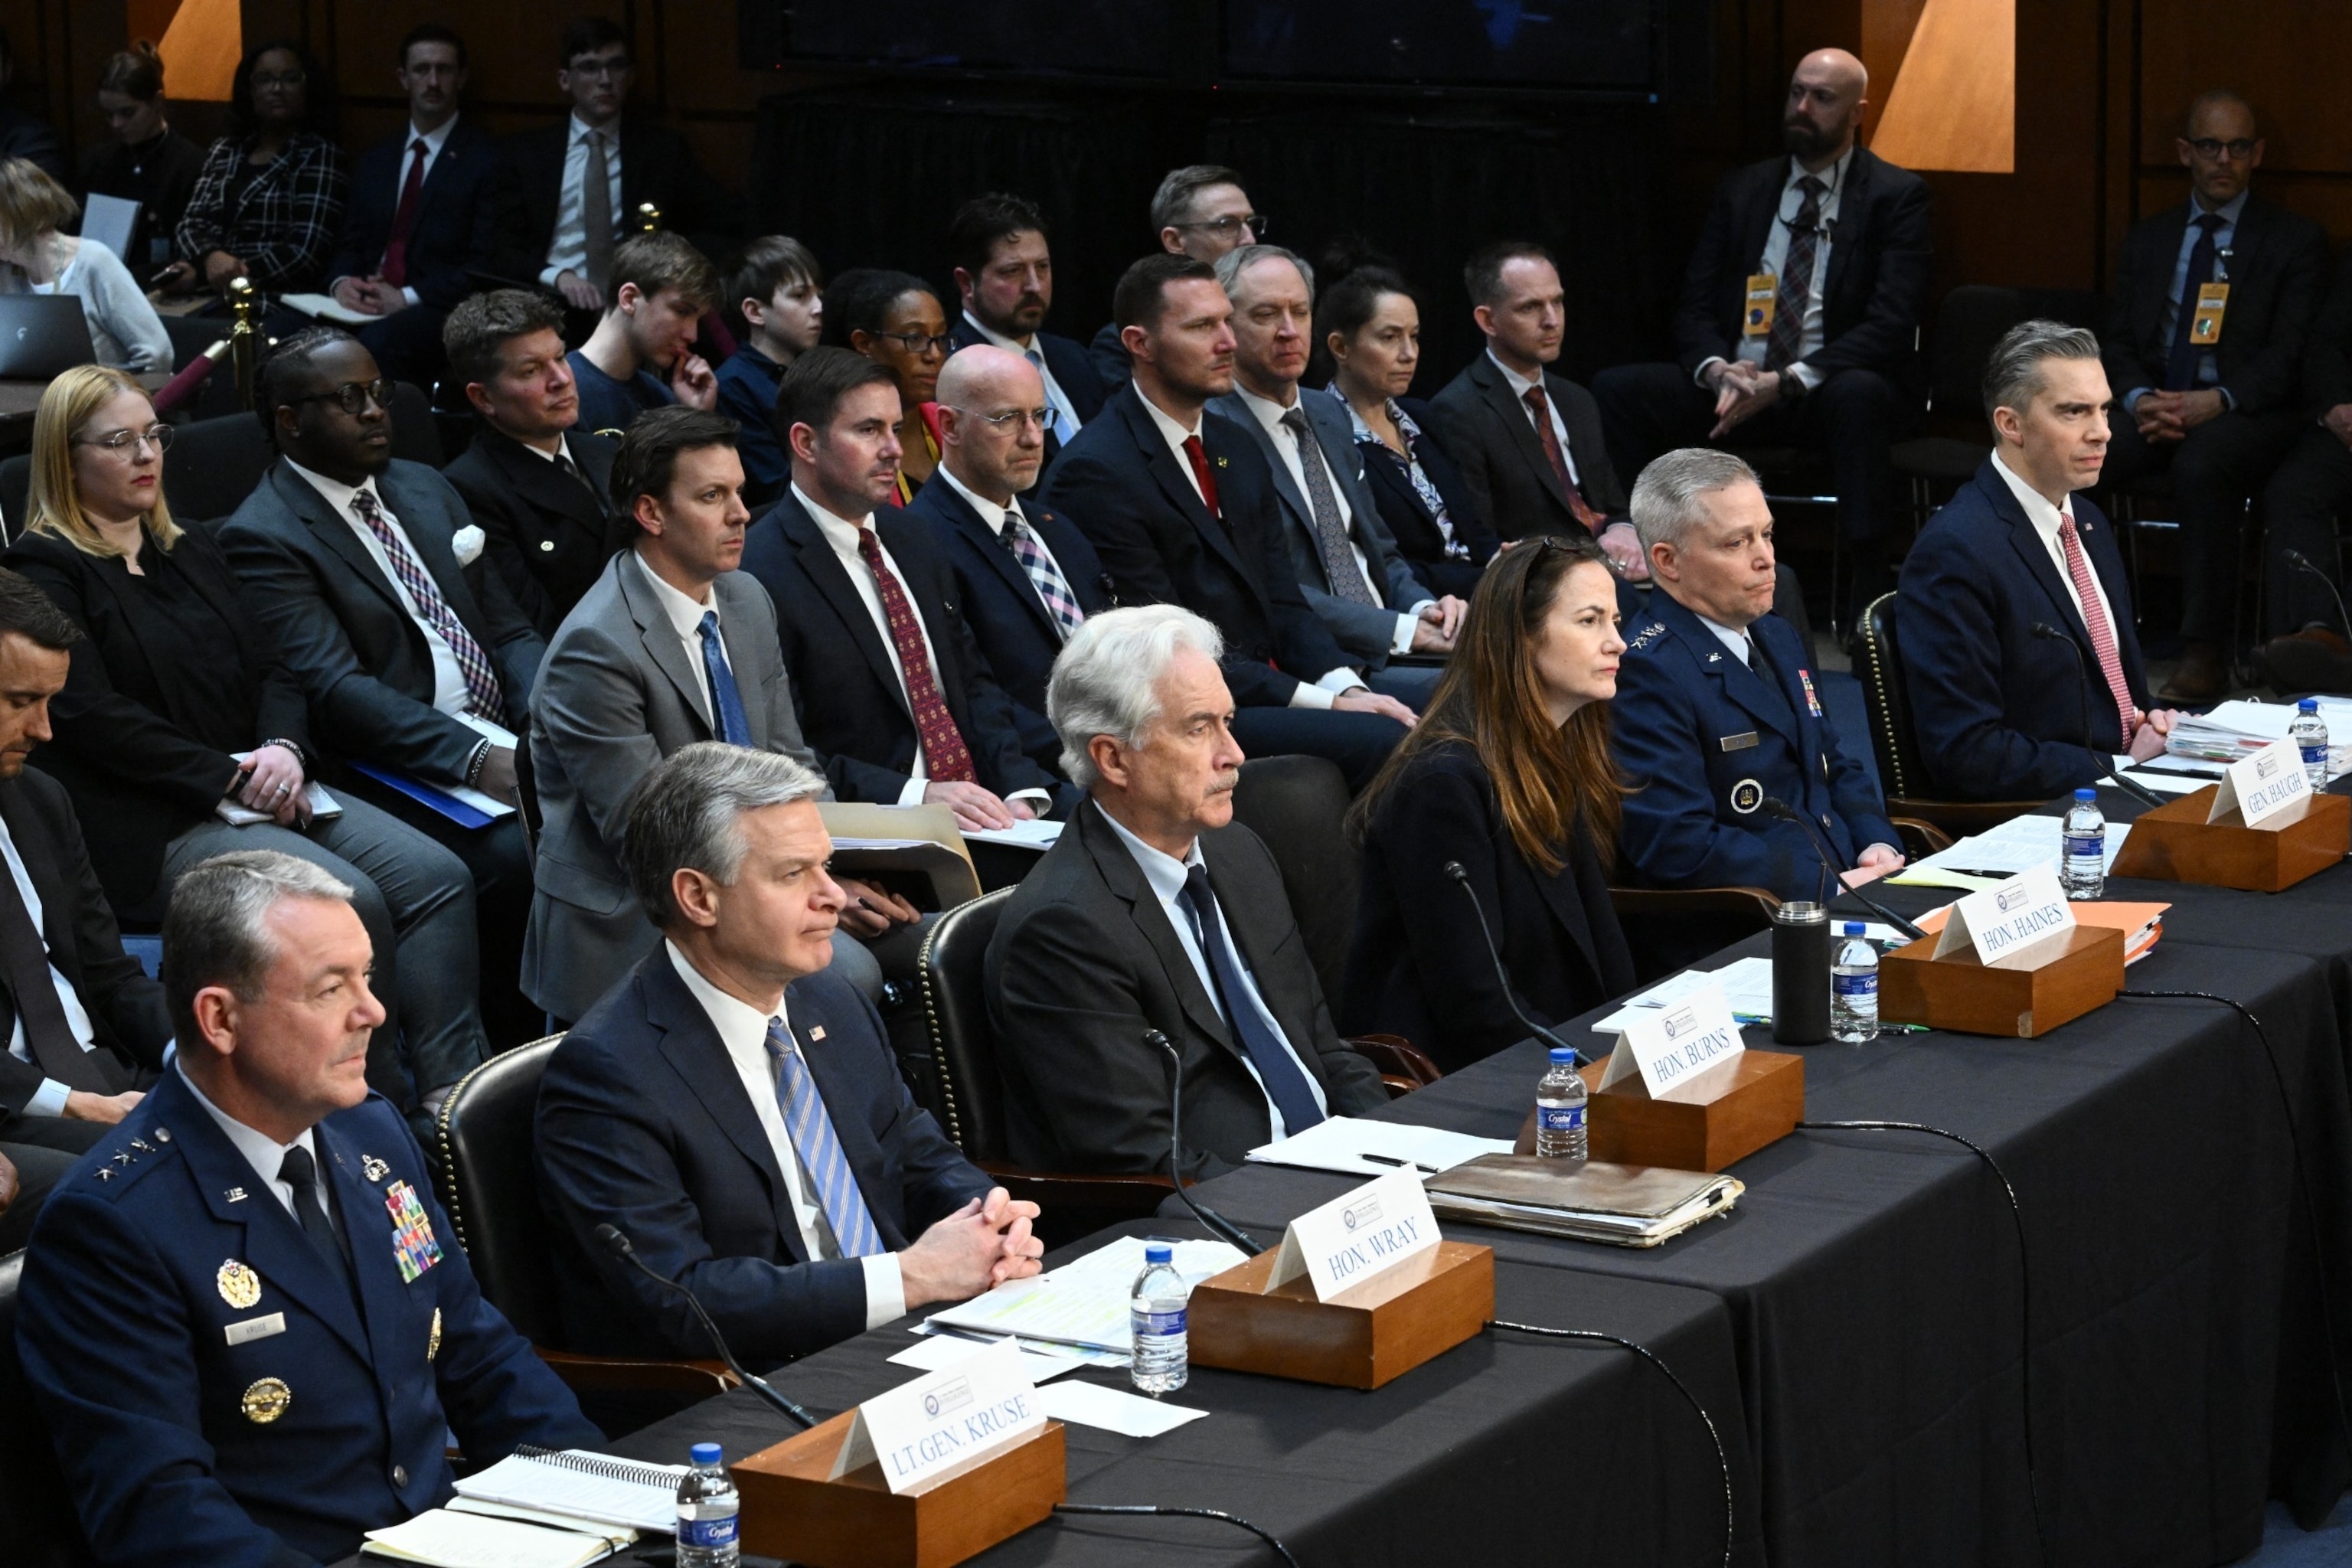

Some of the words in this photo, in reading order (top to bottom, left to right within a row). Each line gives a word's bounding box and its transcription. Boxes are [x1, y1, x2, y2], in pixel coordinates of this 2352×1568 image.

[2248, 789, 2270, 814] GEN.
[2269, 772, 2303, 803] HAUGH
[1982, 923, 2017, 952] HON.
[2014, 903, 2063, 939] HAINES
[1653, 1050, 1687, 1083] HON.
[1684, 1027, 1730, 1066] BURNS
[1549, 1114, 1572, 1124] Crystal
[1328, 1244, 1370, 1281] HON.
[1368, 1216, 1419, 1257] WRAY
[247, 1322, 267, 1334] KRUSE
[965, 1393, 1031, 1442] KRUSE
